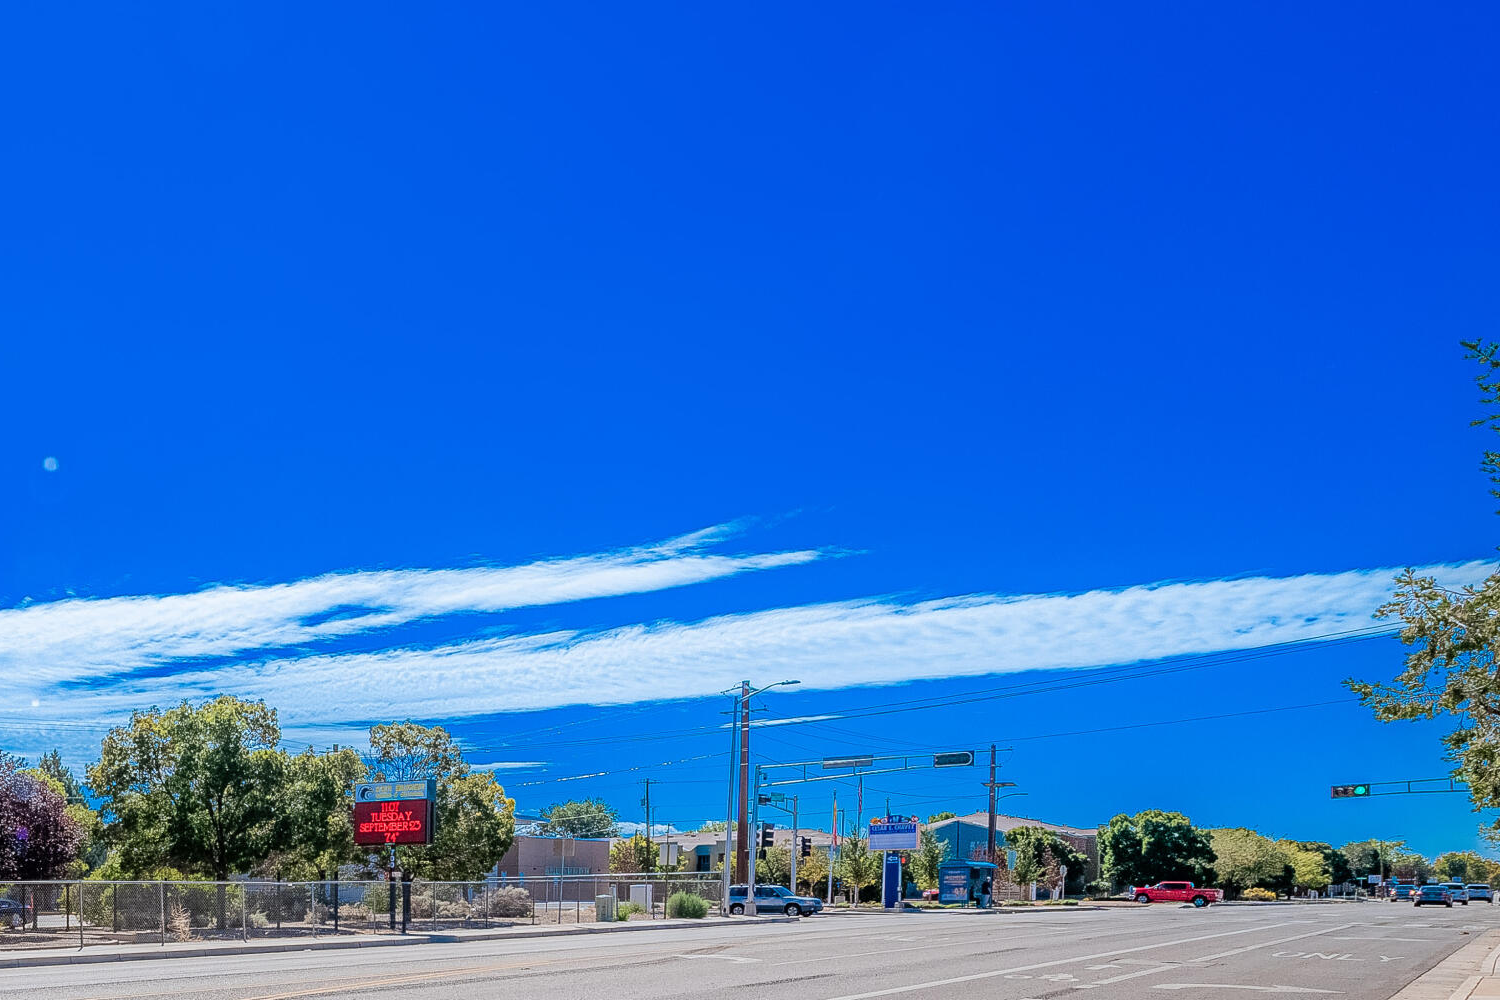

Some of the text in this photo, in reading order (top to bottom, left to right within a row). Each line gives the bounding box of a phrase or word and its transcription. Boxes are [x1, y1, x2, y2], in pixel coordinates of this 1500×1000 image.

[370, 811, 412, 823] TUESDAY
[359, 820, 421, 833] SEPTEMBER 23
